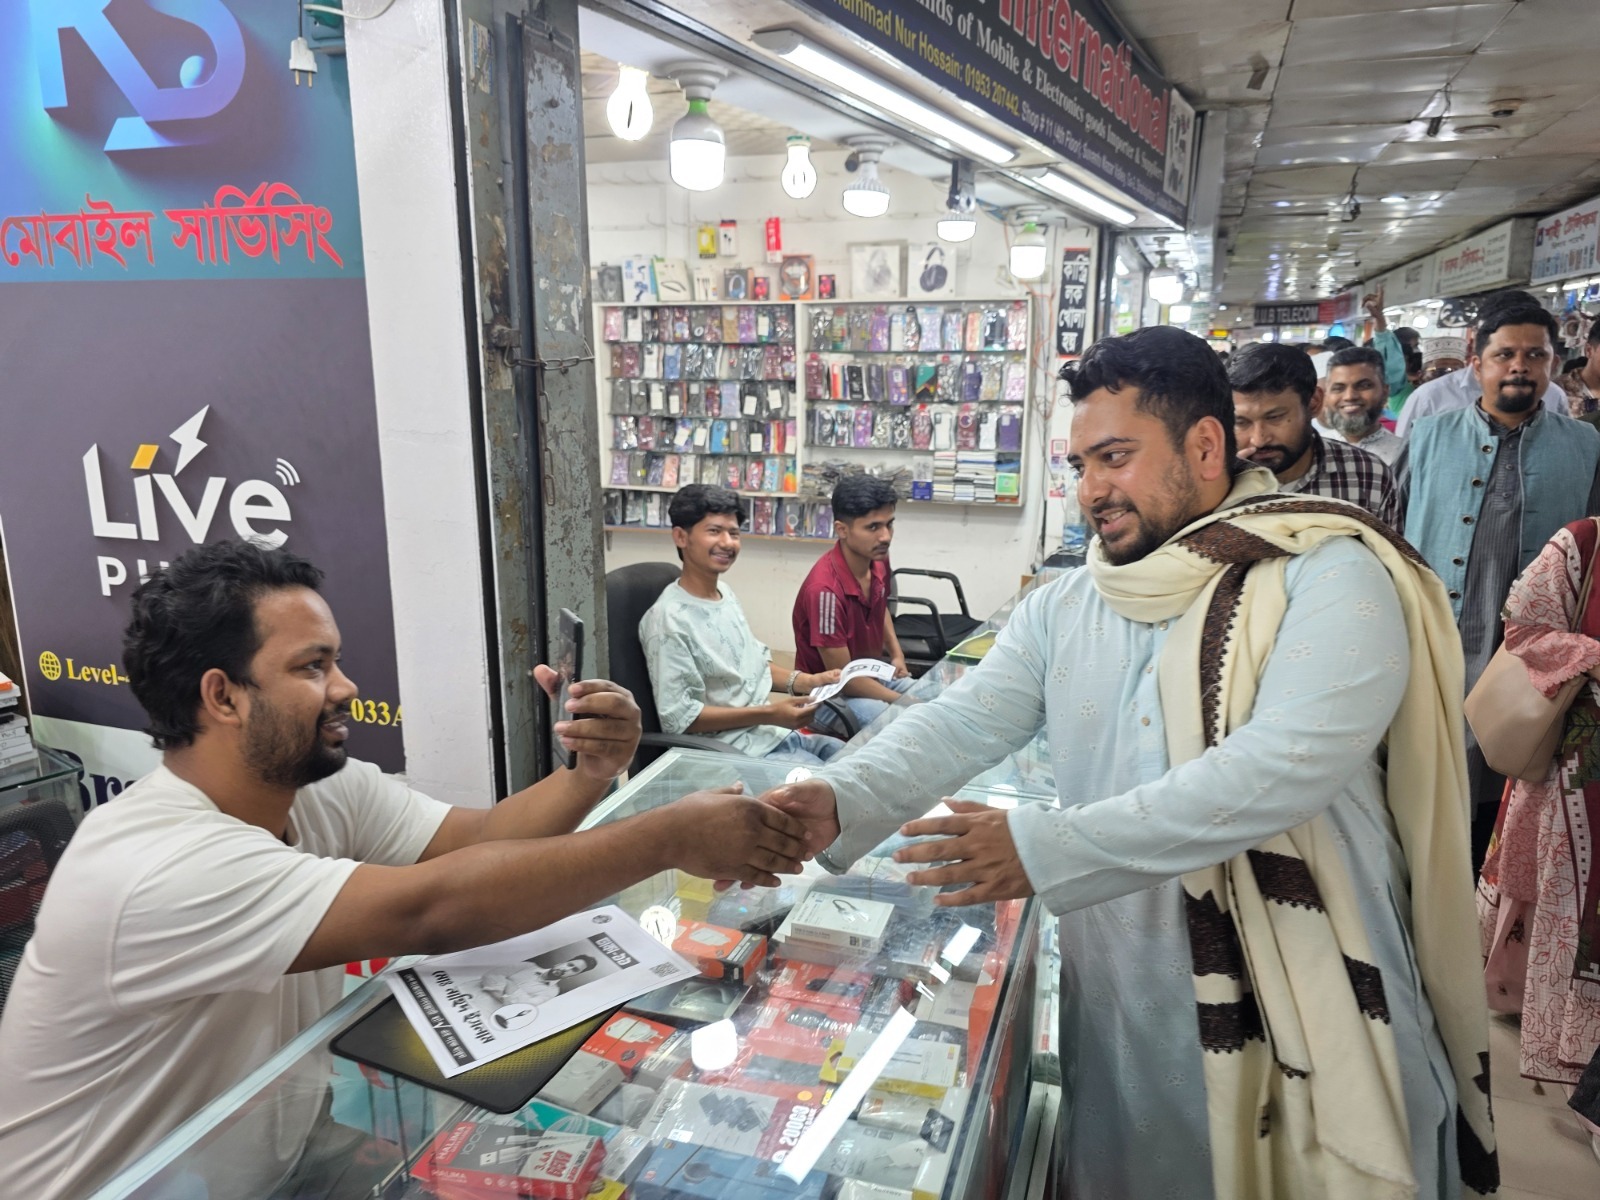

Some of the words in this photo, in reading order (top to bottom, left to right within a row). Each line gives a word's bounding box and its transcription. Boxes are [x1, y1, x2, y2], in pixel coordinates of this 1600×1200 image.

[895, 15, 917, 51] Nur
[919, 31, 962, 82] Hossain:
[965, 63, 991, 98] 01953
[1022, 100, 1039, 133] Shop
[957, 12, 974, 40] of
[976, 19, 1020, 75] Mobile
[1022, 58, 1033, 85] &
[1036, 67, 1084, 123] Electronics
[1, 193, 155, 268] মোবাইল
[165, 182, 345, 268] সার্ভিসিং
[1059, 306, 1087, 328] খোলা
[1064, 284, 1085, 305] লক
[1277, 306, 1318, 323] TELECOM
[82, 443, 292, 551] Live
[65, 658, 130, 686] Level-
[445, 988, 473, 1013] নাহিদ
[463, 1010, 496, 1044] ইসলাম
[436, 1126, 466, 1160] HALIMA
